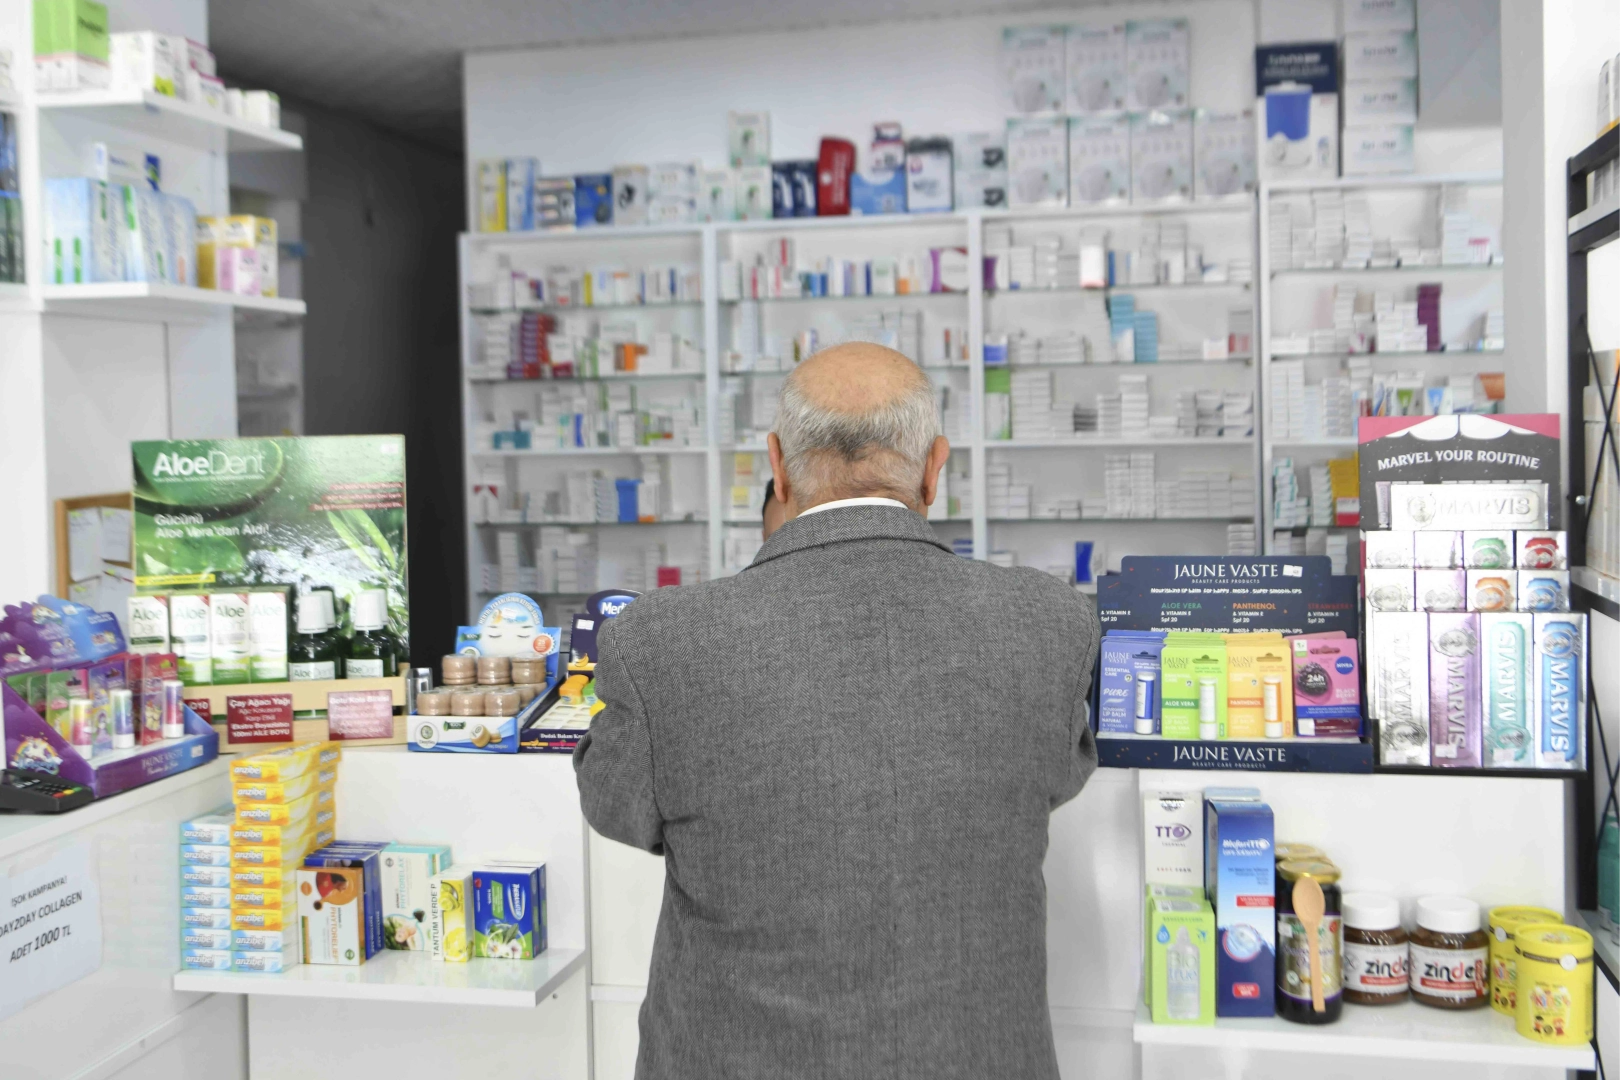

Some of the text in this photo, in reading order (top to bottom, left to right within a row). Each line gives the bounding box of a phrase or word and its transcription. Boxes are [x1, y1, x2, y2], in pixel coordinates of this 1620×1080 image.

[153, 450, 265, 476] AloeDent
[1378, 449, 1540, 470] MARVEL YOUR ROUTINE
[1440, 498, 1531, 516] MARVIS
[155, 527, 184, 538] Aloe
[1174, 564, 1278, 580] JAUNE VASTE
[216, 604, 246, 618] Aloe
[602, 602, 627, 614] Med
[132, 607, 163, 621] Aloe
[1104, 652, 1130, 660] JAUNE
[1498, 629, 1516, 721] MARVIS
[1103, 688, 1129, 697] PURE
[230, 700, 246, 709] Çay
[1448, 656, 1466, 750] MARVIS
[1550, 660, 1570, 751] MARVIS
[1173, 746, 1286, 762] JAUNE VASTE
[234, 765, 262, 775] anzibel
[238, 787, 266, 797] anzibel
[240, 809, 270, 818] anzibel
[184, 829, 213, 838] anzibel
[234, 829, 262, 838] anzibel
[184, 850, 213, 860] anzibel
[234, 850, 264, 860] anzibel
[184, 872, 213, 881] anzibel
[234, 872, 264, 882] anzibel
[28, 876, 68, 899] KAMPANYA!
[184, 892, 213, 902] anzibel
[234, 892, 264, 902] anzibel
[38, 890, 82, 918] COLLAGEN
[184, 913, 214, 923] anzibel
[235, 914, 264, 923] anzibel
[10, 924, 72, 963] ADET 1000 TL
[184, 934, 214, 944] anzibel
[236, 936, 266, 945] anzibel
[185, 954, 214, 964] anzibel
[236, 956, 266, 966] anzibel
